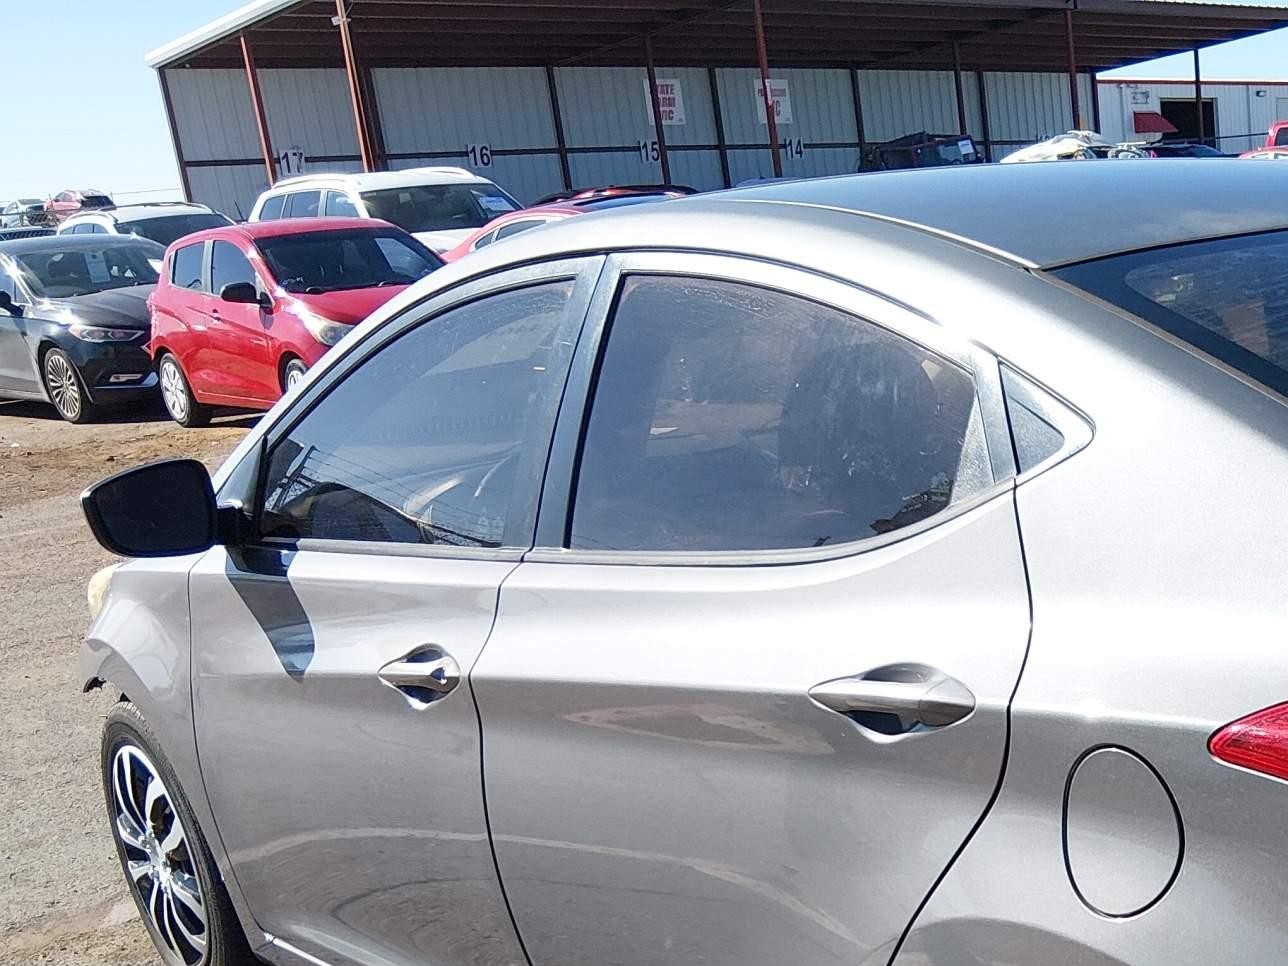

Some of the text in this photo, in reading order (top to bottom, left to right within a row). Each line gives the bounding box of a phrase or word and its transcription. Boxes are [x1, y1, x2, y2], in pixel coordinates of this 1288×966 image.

[281, 151, 304, 173] 17
[469, 146, 491, 167] 16
[641, 141, 660, 162] 15
